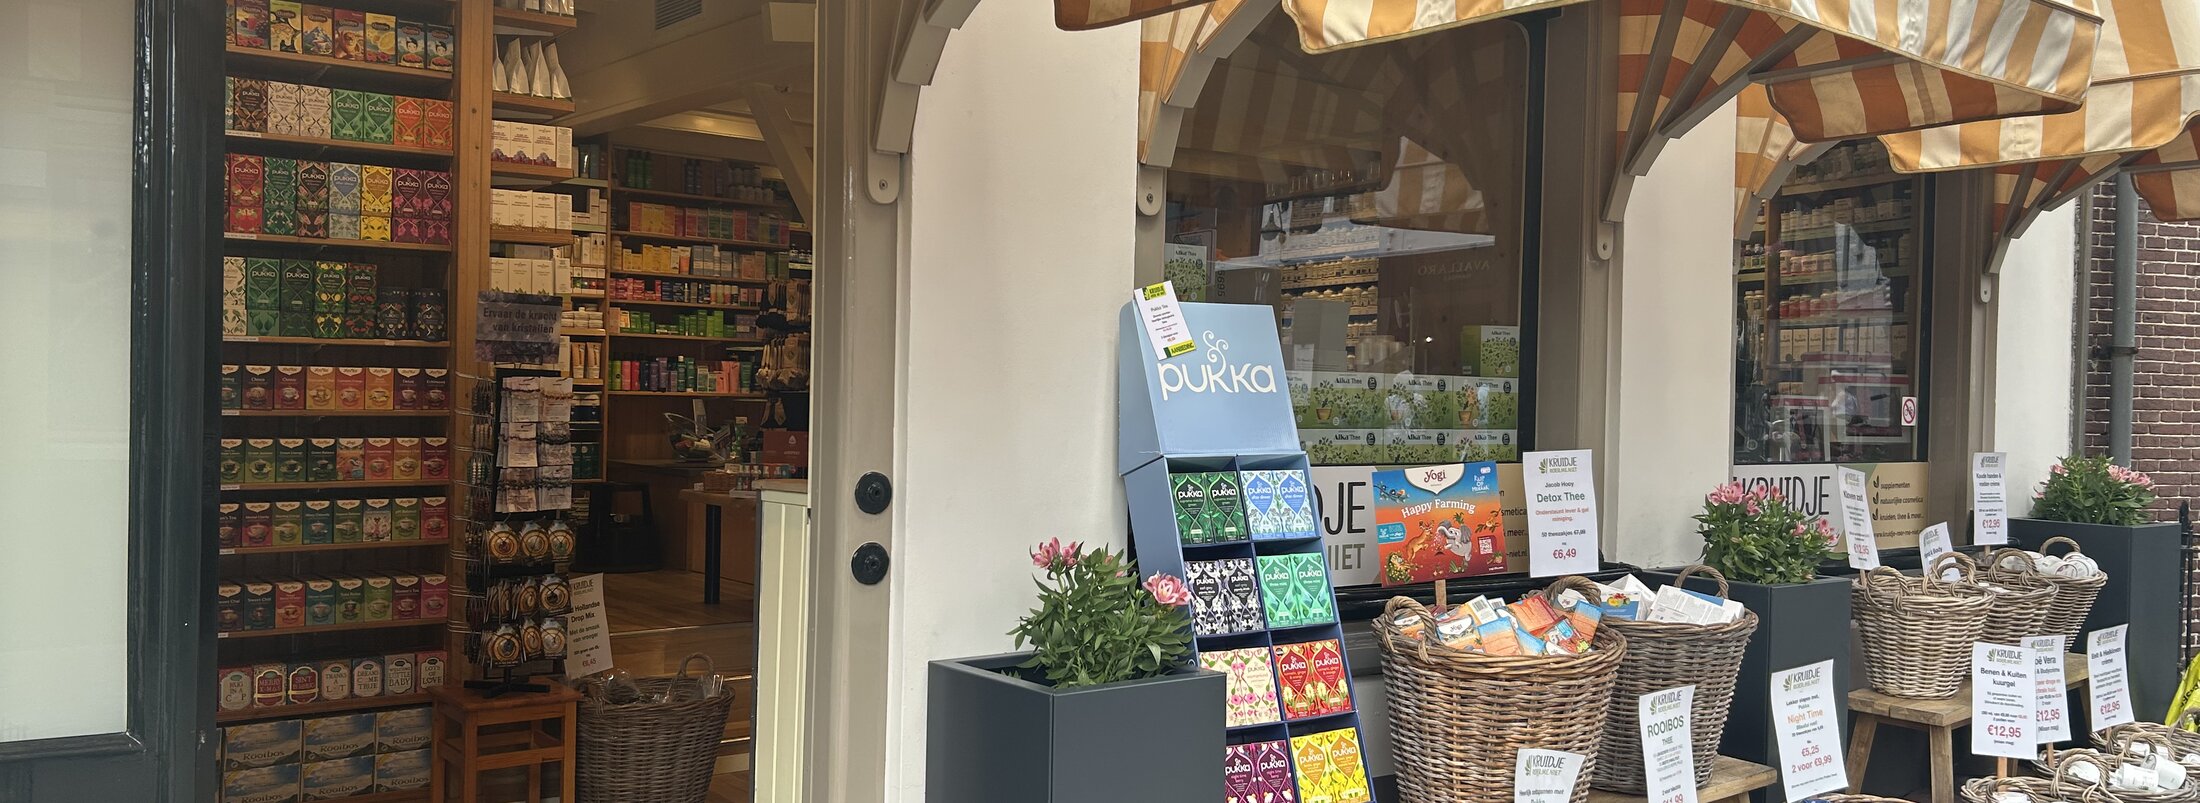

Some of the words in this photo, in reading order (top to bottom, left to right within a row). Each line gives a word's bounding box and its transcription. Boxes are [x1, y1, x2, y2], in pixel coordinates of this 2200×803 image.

[336, 100, 360, 111] pukka
[368, 104, 391, 113] pukka
[399, 107, 421, 117] pukka
[428, 111, 450, 120] pukka
[234, 166, 259, 176] pukka
[302, 171, 325, 181] pukka
[334, 174, 357, 184] pukka
[366, 177, 389, 187] pukka
[398, 180, 419, 190] pukka
[427, 181, 449, 192] pukka
[251, 269, 276, 279] pukka
[286, 270, 310, 280] pukka
[483, 307, 513, 319] Ervaar
[515, 309, 526, 319] de
[529, 310, 557, 321] kracht
[493, 323, 509, 331] van
[512, 322, 554, 334] kristallen
[1157, 346, 1276, 400] pukka
[1549, 457, 1577, 467] KRUIDJE
[1248, 485, 1271, 495] pukka
[1281, 484, 1304, 494] pukka
[1880, 482, 1910, 490] supplementen
[1178, 488, 1203, 499] pukka
[1212, 486, 1236, 498] pukka
[1537, 494, 1562, 503] Detox
[1564, 492, 1585, 501] Thee
[1880, 497, 1900, 506] natuurlijke
[1401, 501, 1432, 518] Happy
[1435, 499, 1476, 514] Farming
[1982, 519, 2000, 528] €12,95
[1553, 548, 1577, 560] €6,49
[1231, 573, 1249, 583] pukka
[1265, 570, 1289, 581] pukka
[1299, 568, 1323, 579] pukka
[1196, 576, 1214, 586] pukka
[575, 601, 600, 612] Hollandse
[571, 614, 584, 623] Drop
[1997, 649, 2022, 660] KRUIDJE
[2043, 656, 2056, 664] Vera
[1282, 660, 1307, 672] pukka
[1315, 657, 1339, 668] pukka
[1793, 667, 1821, 682] KRUIDJE
[1980, 668, 2000, 676] Benen
[2007, 671, 2027, 679] Kuiten
[388, 678, 411, 687] BABY
[1993, 679, 2016, 687] kuurgel
[1657, 690, 1682, 705] KRUIDJE
[1786, 698, 1799, 706] Lekker
[2100, 701, 2120, 715] €12,95
[1788, 713, 1806, 724] Night
[1807, 708, 1823, 718] Time
[1647, 715, 1684, 738] ROOIBOS
[1987, 725, 2021, 738] €12,95
[392, 736, 430, 745] Rooibos
[320, 743, 359, 753] Rooibos
[1333, 746, 1356, 757] pukka
[1801, 745, 1820, 757] €5,25
[243, 750, 285, 761] Rooibos
[1299, 752, 1324, 763] pukka
[1260, 758, 1286, 772] pukka
[1533, 755, 1566, 768] KRUIDJE
[1792, 765, 1796, 773] 2
[1797, 761, 1813, 772] voor
[1814, 754, 1832, 767] €9,99
[1225, 761, 1251, 775] pukka
[391, 777, 430, 786] Rooibos
[319, 785, 358, 795] Rooibos
[242, 794, 283, 803] Rooibos
